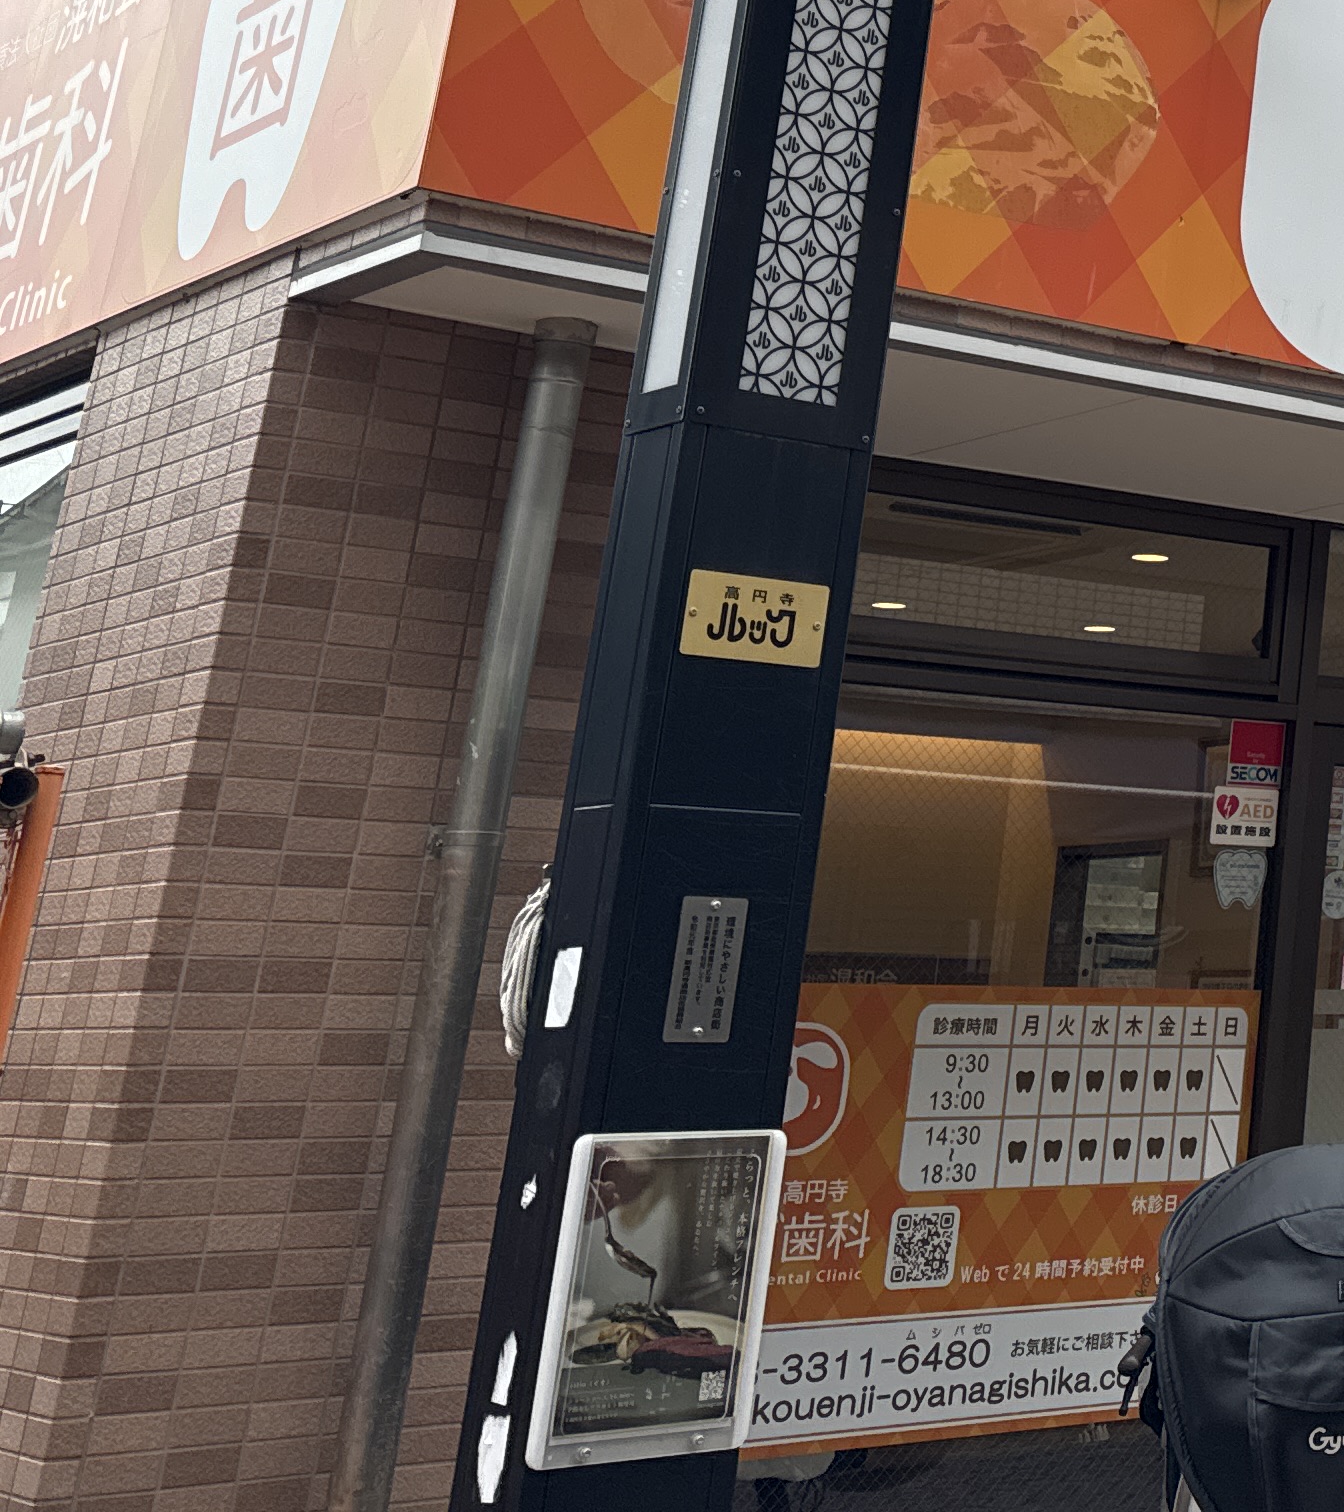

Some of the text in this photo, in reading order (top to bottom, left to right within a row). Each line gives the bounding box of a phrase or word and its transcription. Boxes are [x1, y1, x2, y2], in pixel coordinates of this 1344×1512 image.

[724, 586, 795, 606] 高円寺
[1230, 765, 1278, 783] SECOM
[1239, 804, 1275, 820] AED
[1216, 824, 1272, 837] 設置施設
[932, 1015, 1239, 1037] 診療時間 月 火 水 木 金 土 日
[945, 1053, 989, 1074] 9:30
[929, 1091, 985, 1111] 13:00
[925, 1125, 981, 1147] 14:30
[920, 1162, 977, 1185] 18:30
[782, 1178, 849, 1205] 高円寺
[776, 1208, 871, 1263] 歯科
[816, 1268, 863, 1284] Clinic
[960, 1265, 990, 1284] Web
[1013, 1262, 1031, 1281] 24
[1034, 1255, 1145, 1280] 時間予約受付中
[754, 1338, 991, 1386] -3311-6480
